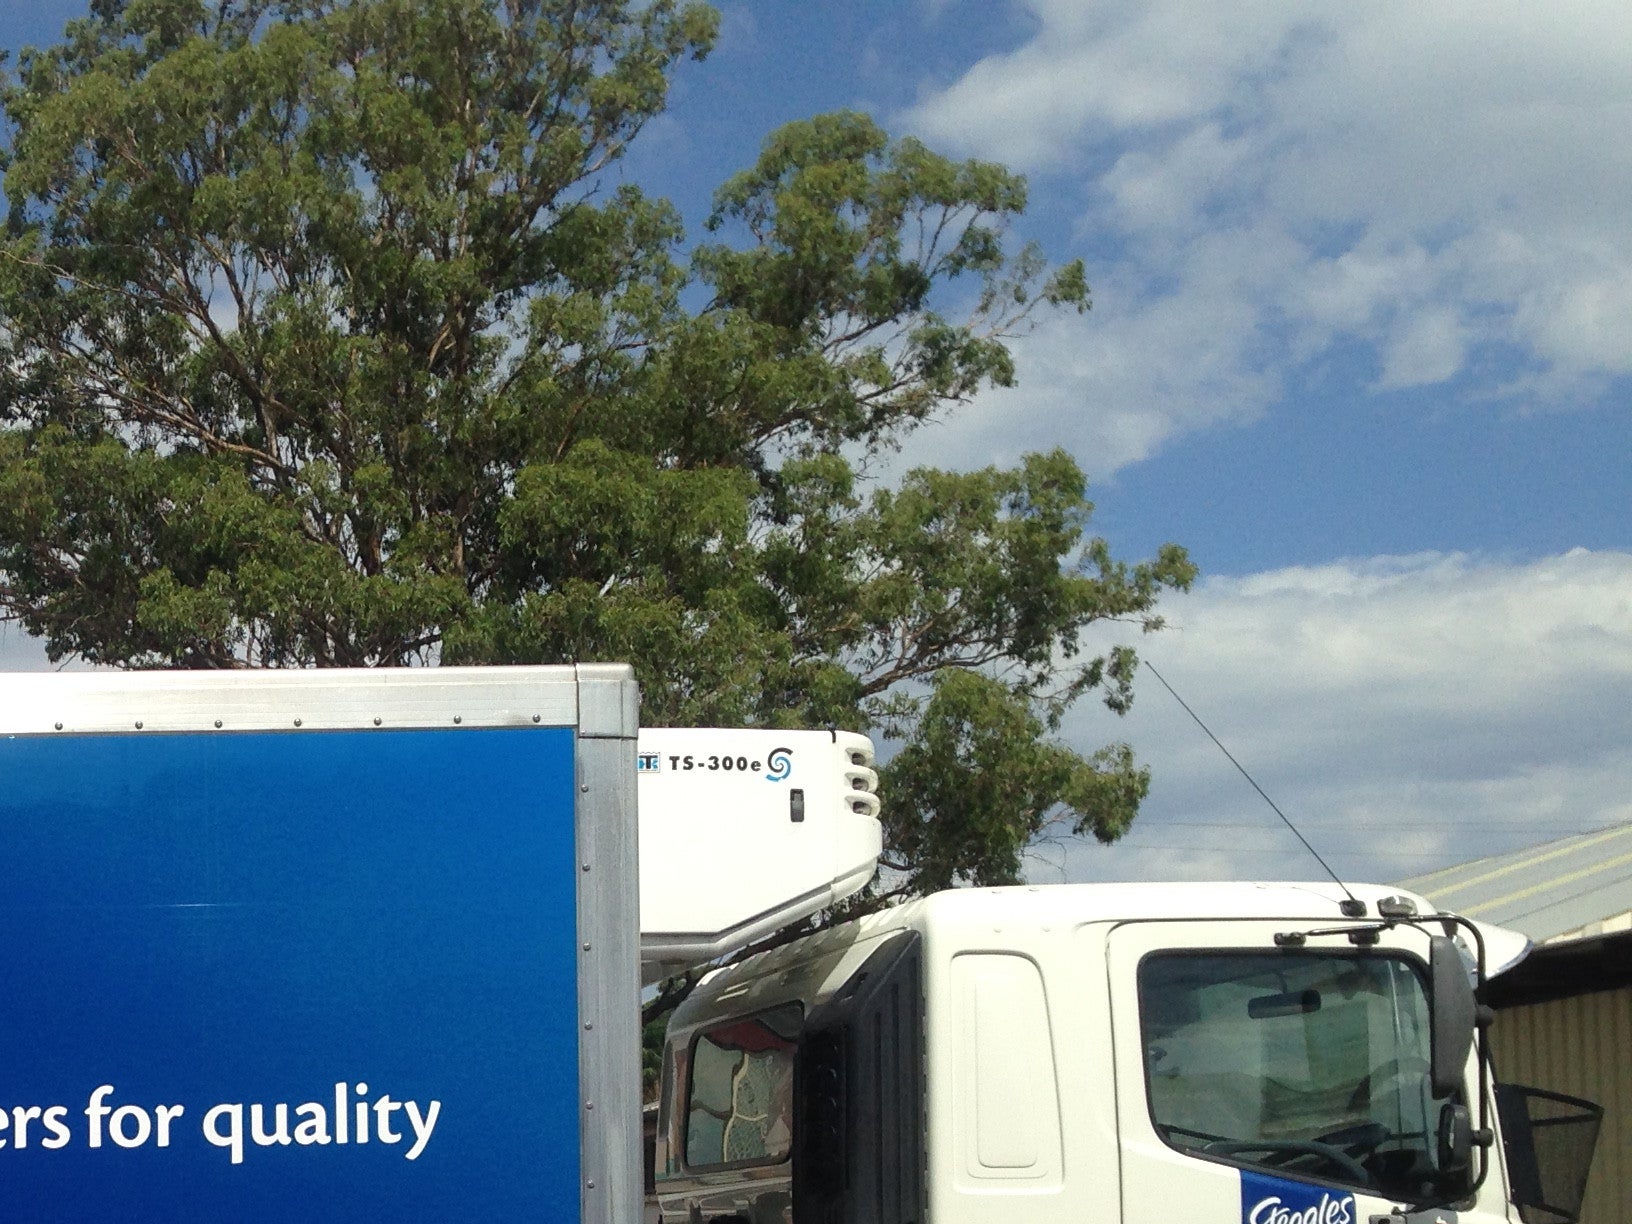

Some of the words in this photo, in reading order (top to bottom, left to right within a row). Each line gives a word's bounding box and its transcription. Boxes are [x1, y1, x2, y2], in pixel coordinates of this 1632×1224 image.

[668, 755, 762, 772] TS-300e
[84, 1084, 185, 1148] for
[202, 1081, 441, 1165] quality
